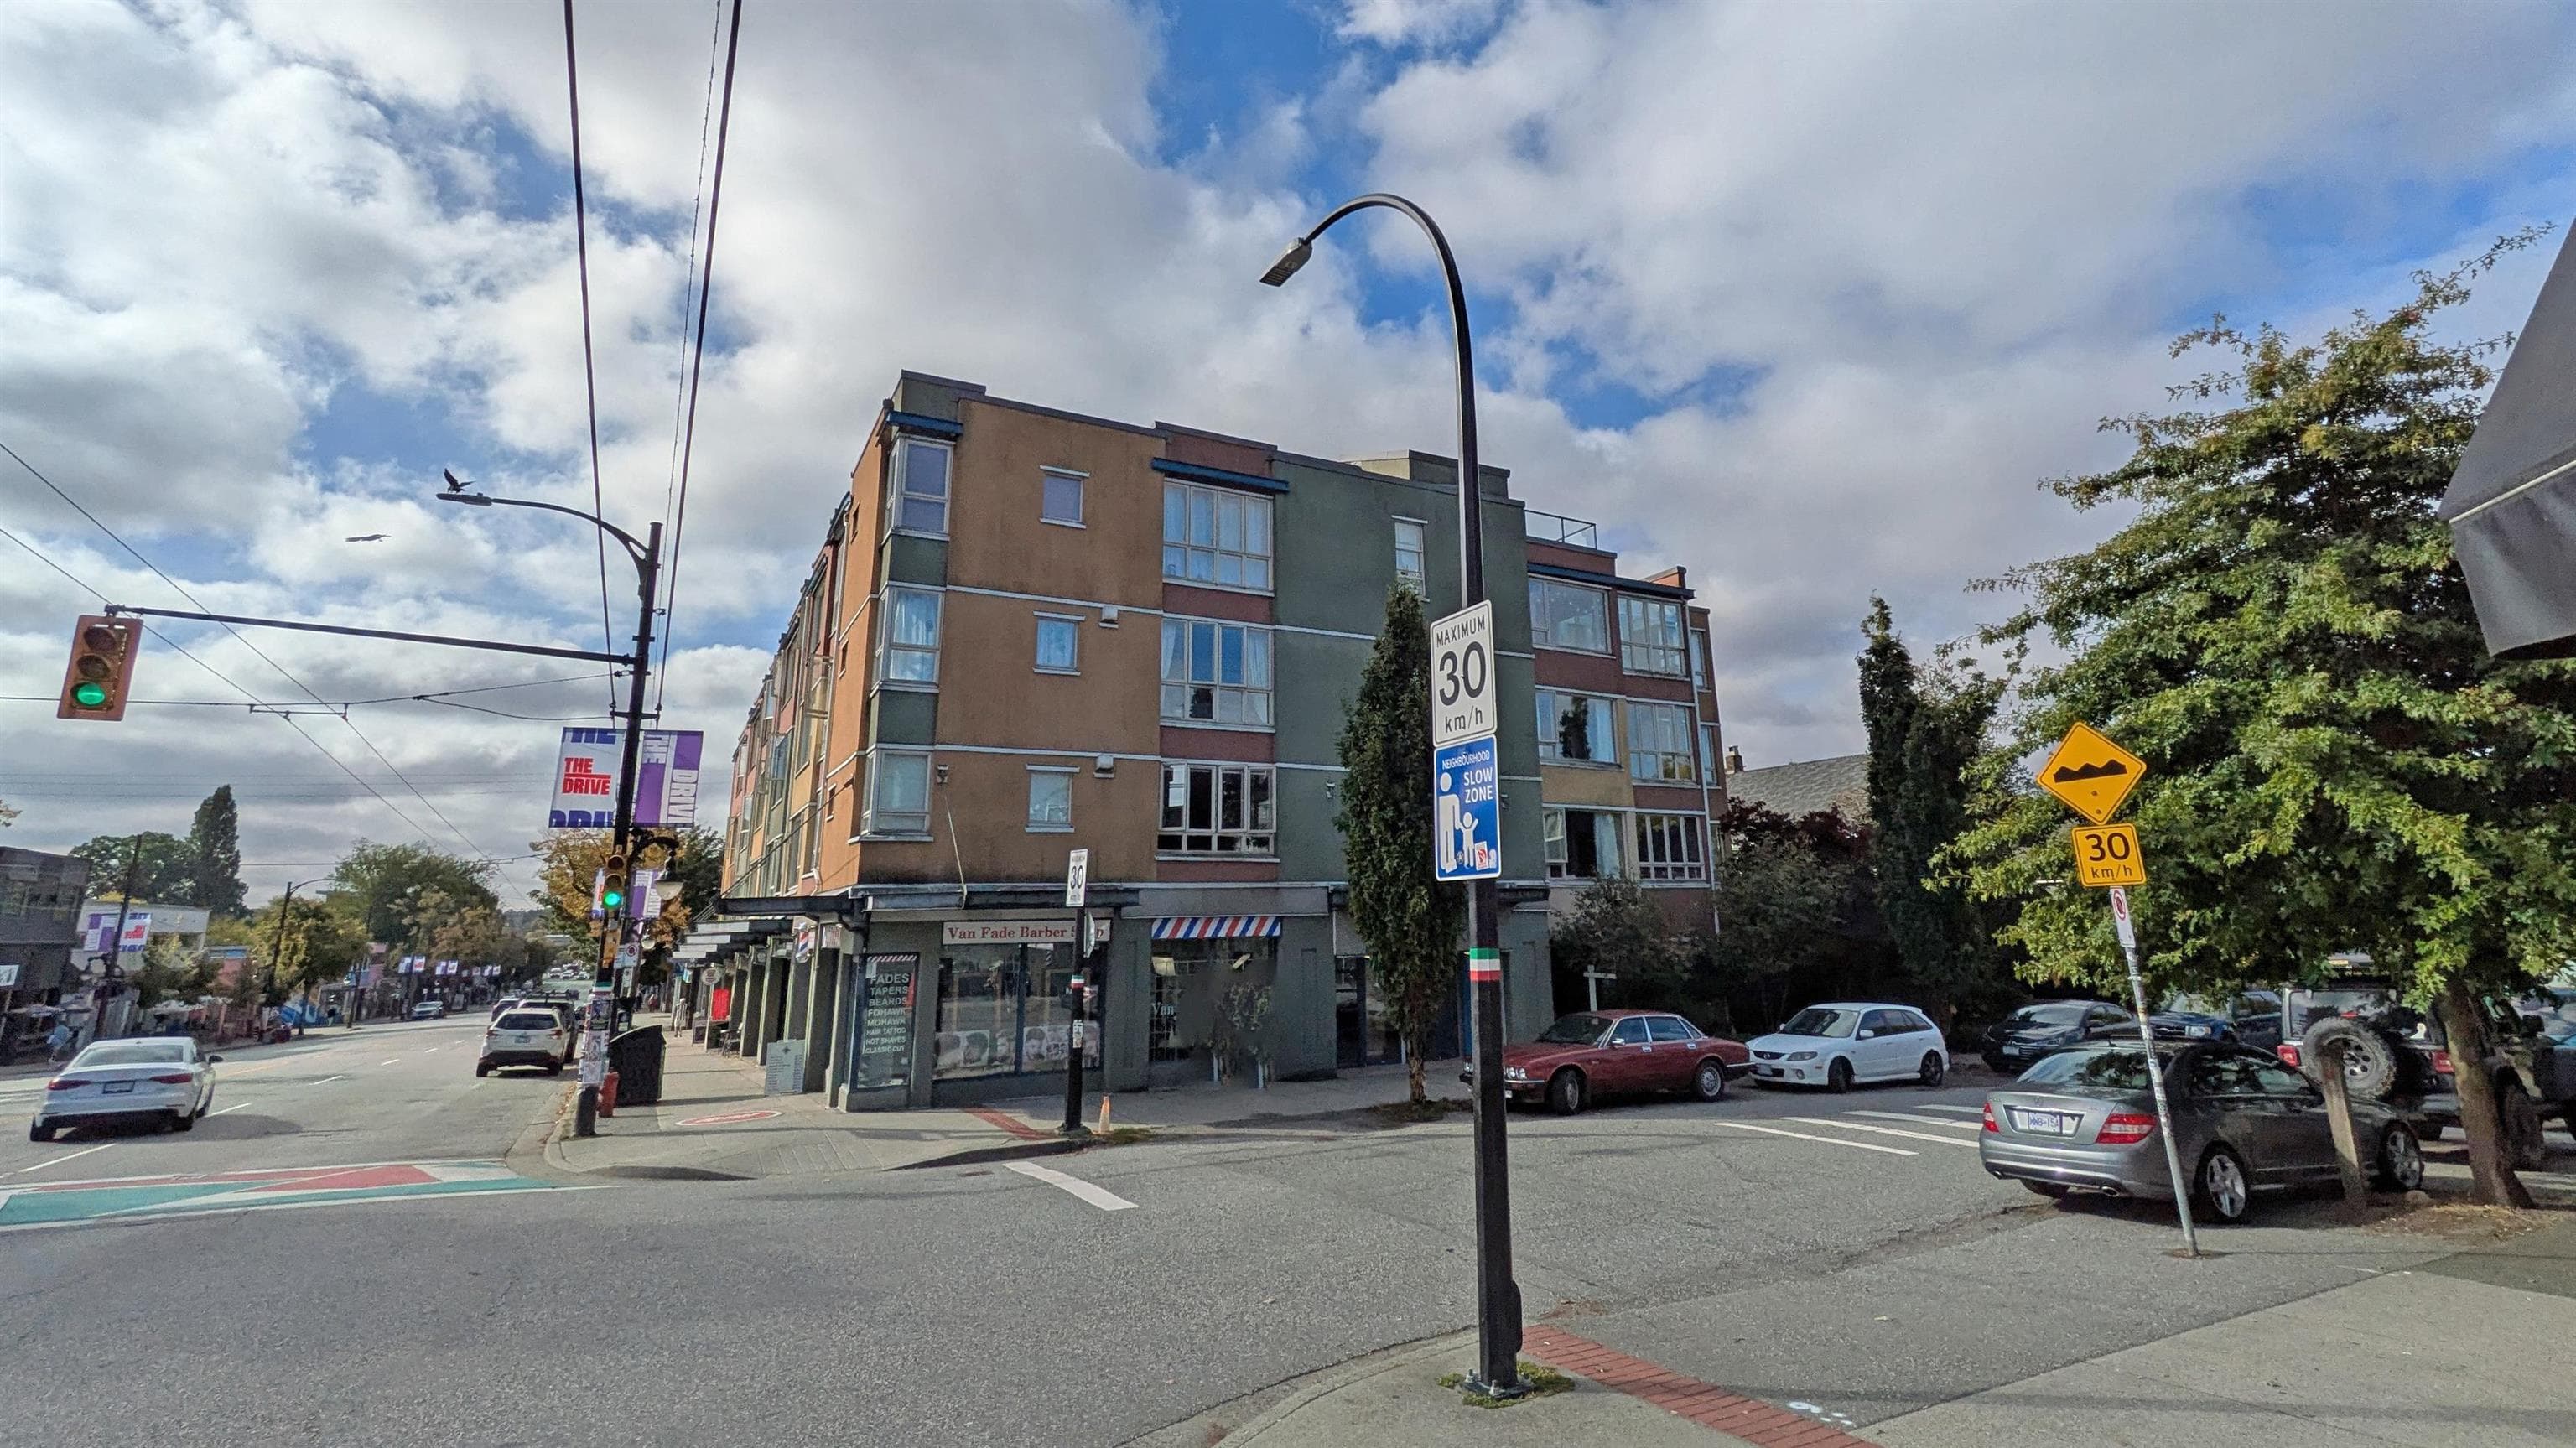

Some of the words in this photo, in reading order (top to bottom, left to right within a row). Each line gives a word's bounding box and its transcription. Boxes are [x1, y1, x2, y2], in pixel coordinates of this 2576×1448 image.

[1436, 615, 1485, 648] MAXIMUM
[1439, 641, 1487, 706] 30
[1445, 705, 1483, 734] km/h
[564, 757, 594, 774] THE
[1441, 750, 1490, 771] NEIGHBOURHOOD
[1463, 767, 1493, 786] SLOW
[562, 778, 612, 796] DRIVE
[1464, 785, 1493, 804] ZONE
[2085, 832, 2131, 862] 30
[1070, 864, 1084, 890] 30
[2090, 864, 2133, 880] km/h
[948, 927, 976, 940] Van
[980, 926, 1015, 939] Fade
[1020, 926, 1067, 938] Barber
[870, 973, 910, 985] FADES
[870, 986, 908, 996] TAPERS
[869, 997, 907, 1007] BEARDS
[1151, 1002, 1174, 1016] Van
